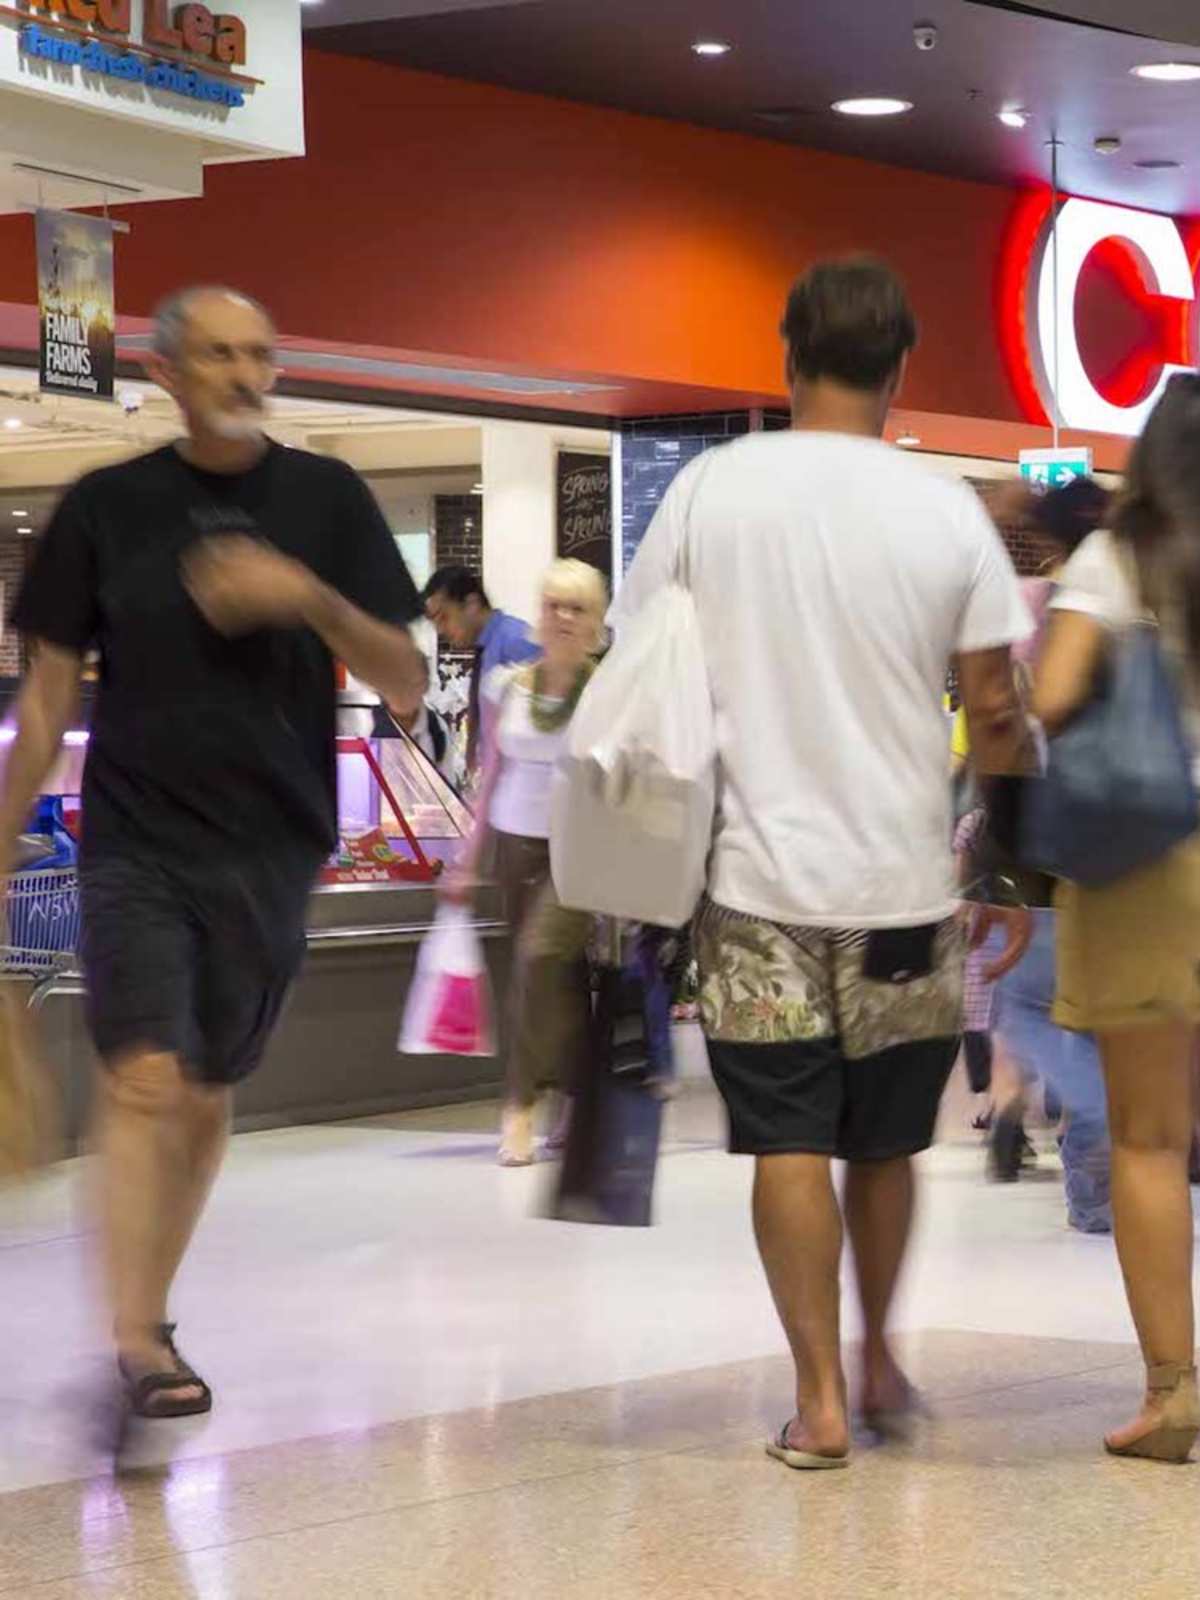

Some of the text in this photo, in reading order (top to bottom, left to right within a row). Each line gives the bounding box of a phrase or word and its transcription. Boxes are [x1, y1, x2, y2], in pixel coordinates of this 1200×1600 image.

[143, 0, 247, 66] Lea
[46, 313, 89, 346] FAMILY
[46, 341, 91, 374] FARMS
